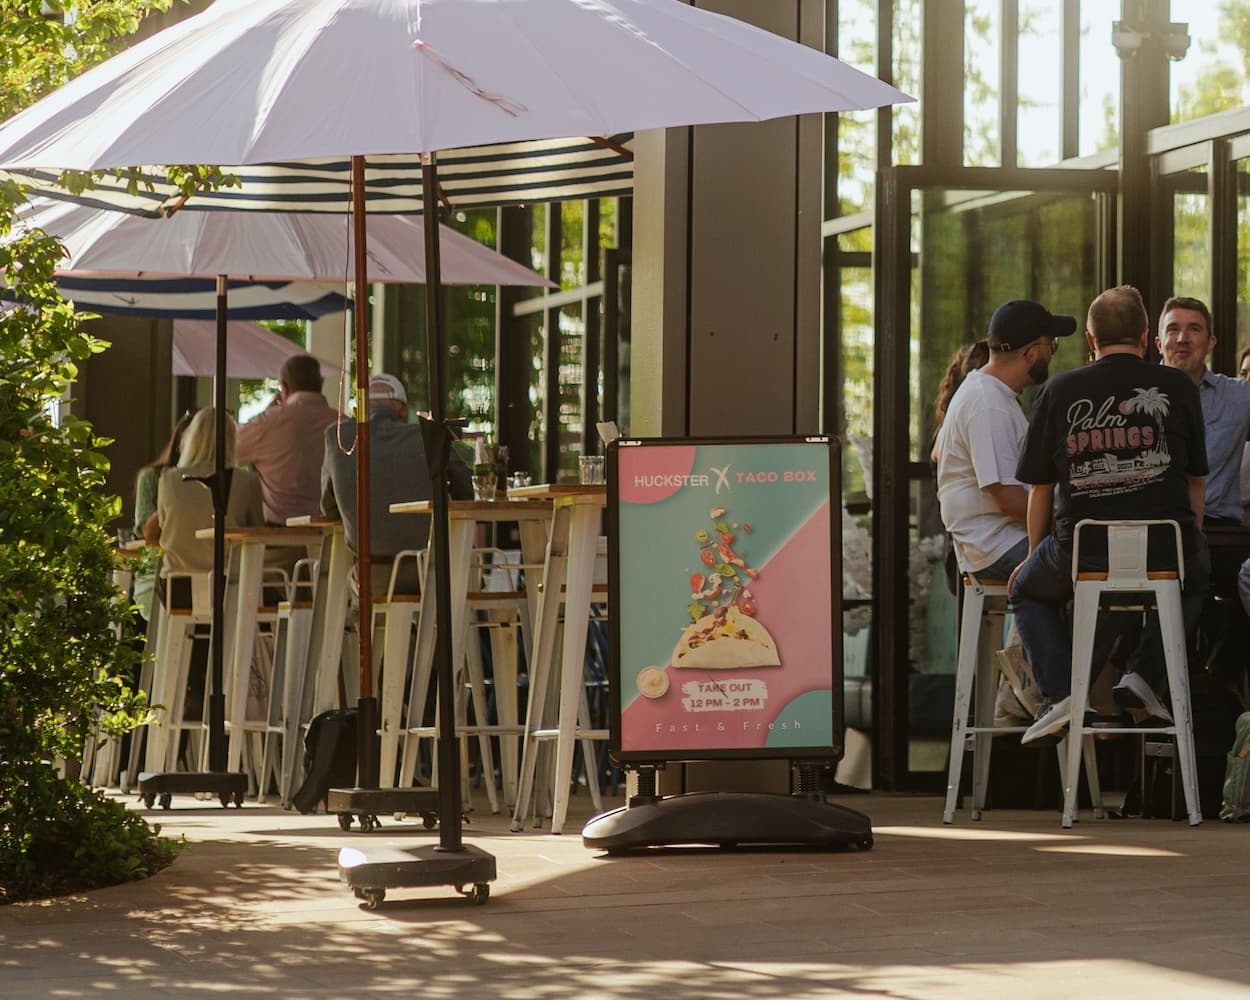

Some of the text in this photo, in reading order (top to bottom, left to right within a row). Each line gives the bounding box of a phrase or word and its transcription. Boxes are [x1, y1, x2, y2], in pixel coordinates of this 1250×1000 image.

[1066, 395, 1127, 436] Palm
[1065, 425, 1154, 457] SPRINGS
[635, 475, 709, 488] HUCKSTER
[735, 471, 778, 484] TACO
[783, 470, 817, 483] BOX
[698, 683, 753, 693] TAKE OUT
[690, 698, 703, 708] 12
[705, 698, 723, 708] PM
[733, 698, 741, 708] 2
[743, 697, 760, 707] PM
[655, 720, 801, 733] Fast & Fresh
